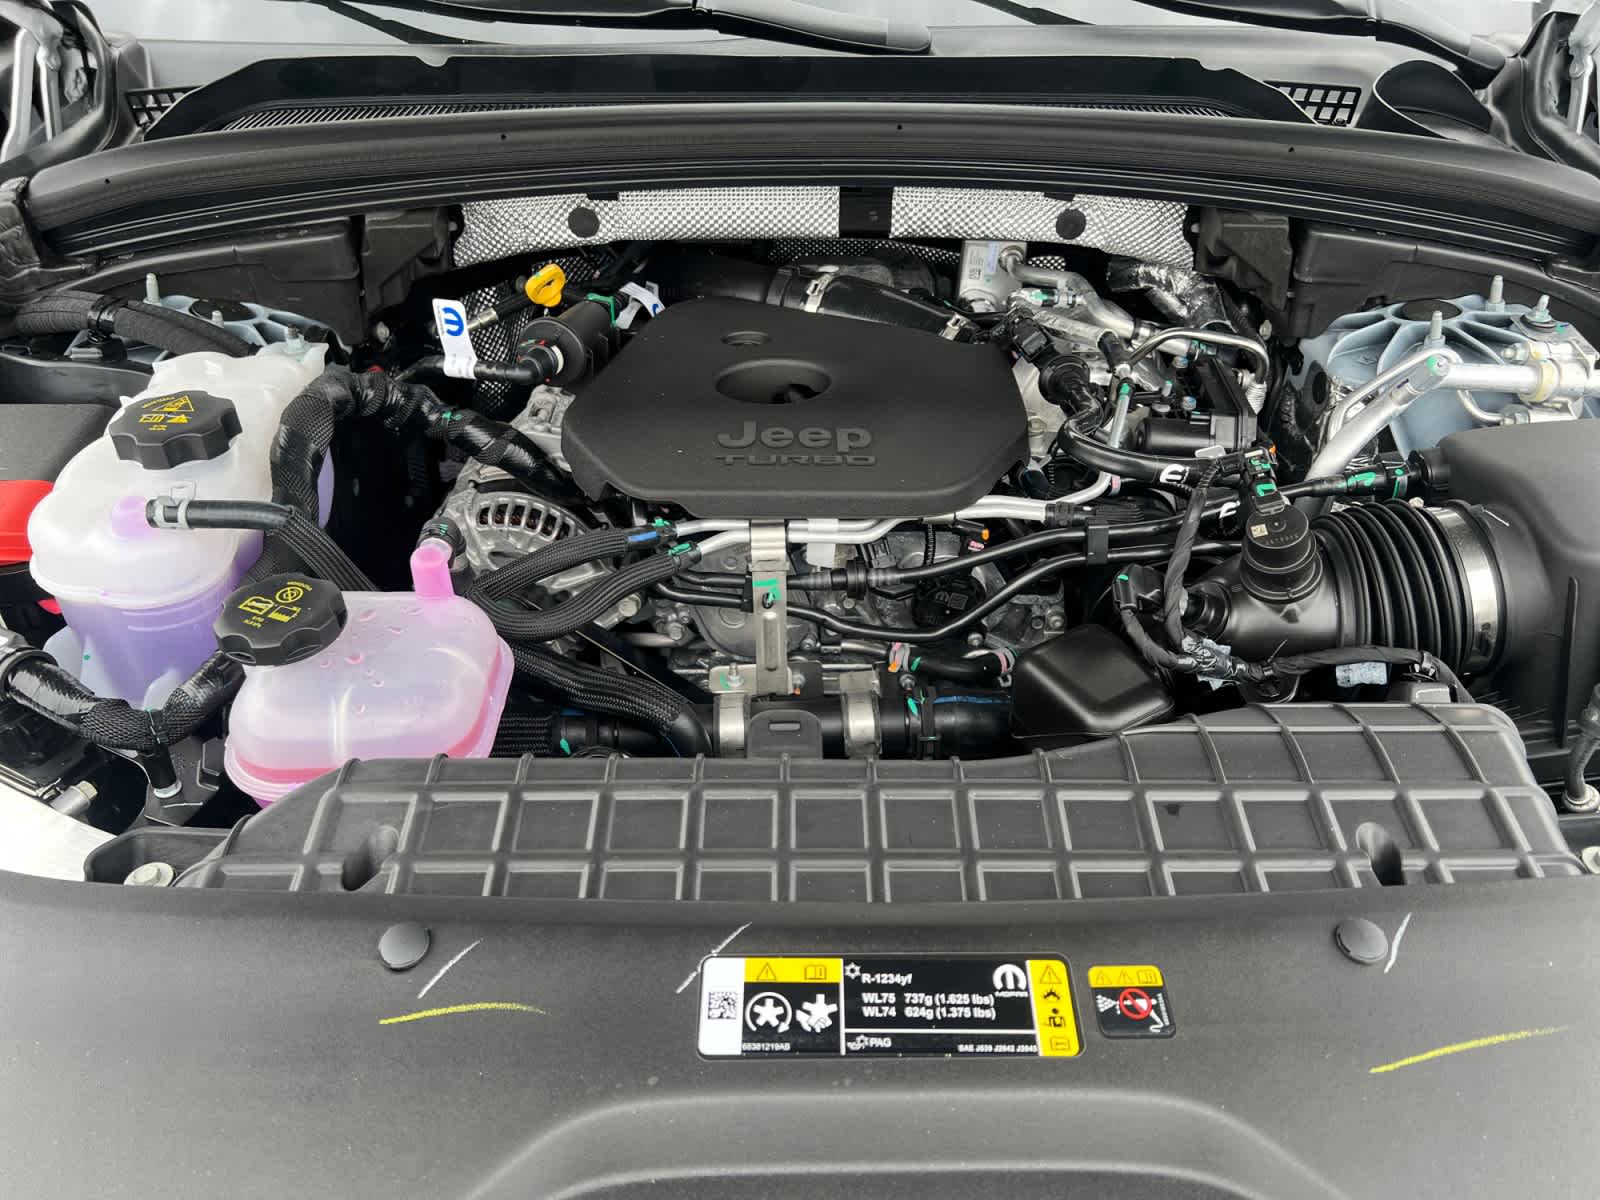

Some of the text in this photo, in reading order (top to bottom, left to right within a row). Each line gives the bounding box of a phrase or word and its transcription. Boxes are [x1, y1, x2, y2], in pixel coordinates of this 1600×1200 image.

[717, 419, 873, 453] Jeep
[715, 455, 877, 467] TURBO
[861, 972, 913, 987] R-1234yf
[861, 992, 995, 1007] WL75 737g (1.625 lbs)
[861, 1006, 996, 1020] WL74 624g (1.375 lbs)
[864, 1036, 892, 1048] PAG
